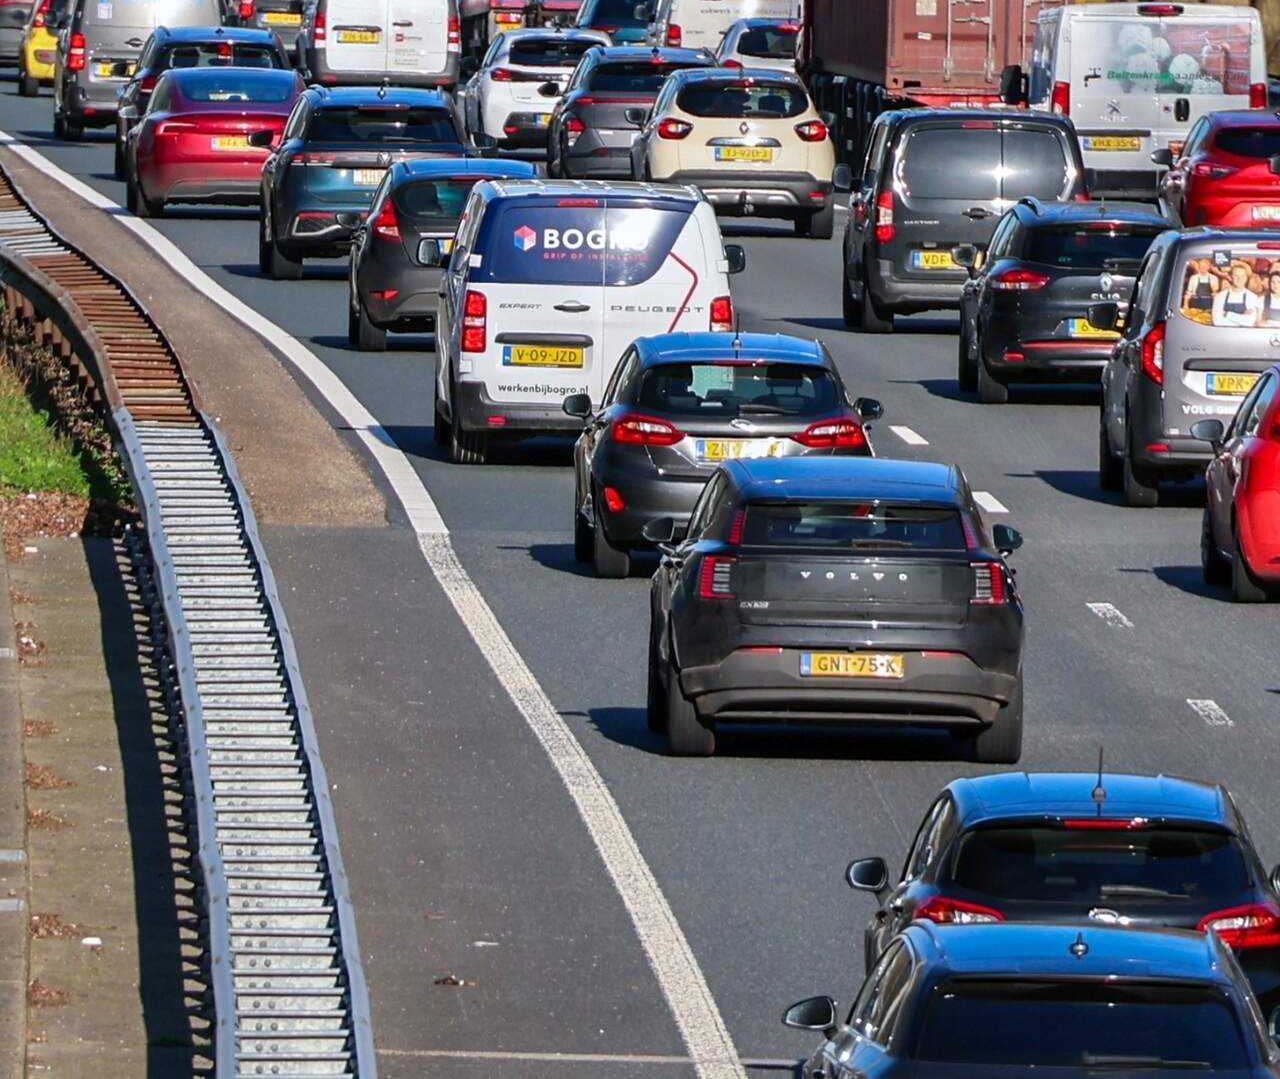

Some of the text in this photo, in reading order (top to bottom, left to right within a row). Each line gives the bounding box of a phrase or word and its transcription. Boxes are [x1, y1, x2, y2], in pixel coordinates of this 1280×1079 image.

[1090, 292, 1121, 301] CLIO
[499, 302, 543, 310] EXPERT
[610, 304, 705, 313] PEUGEOT
[514, 348, 578, 364] V-09-JZD
[497, 383, 590, 397] werkenbijbogro.nl
[1182, 404, 1215, 415] VOLG
[800, 571, 908, 582] VOLVO
[817, 656, 896, 673] GNT-75-K
